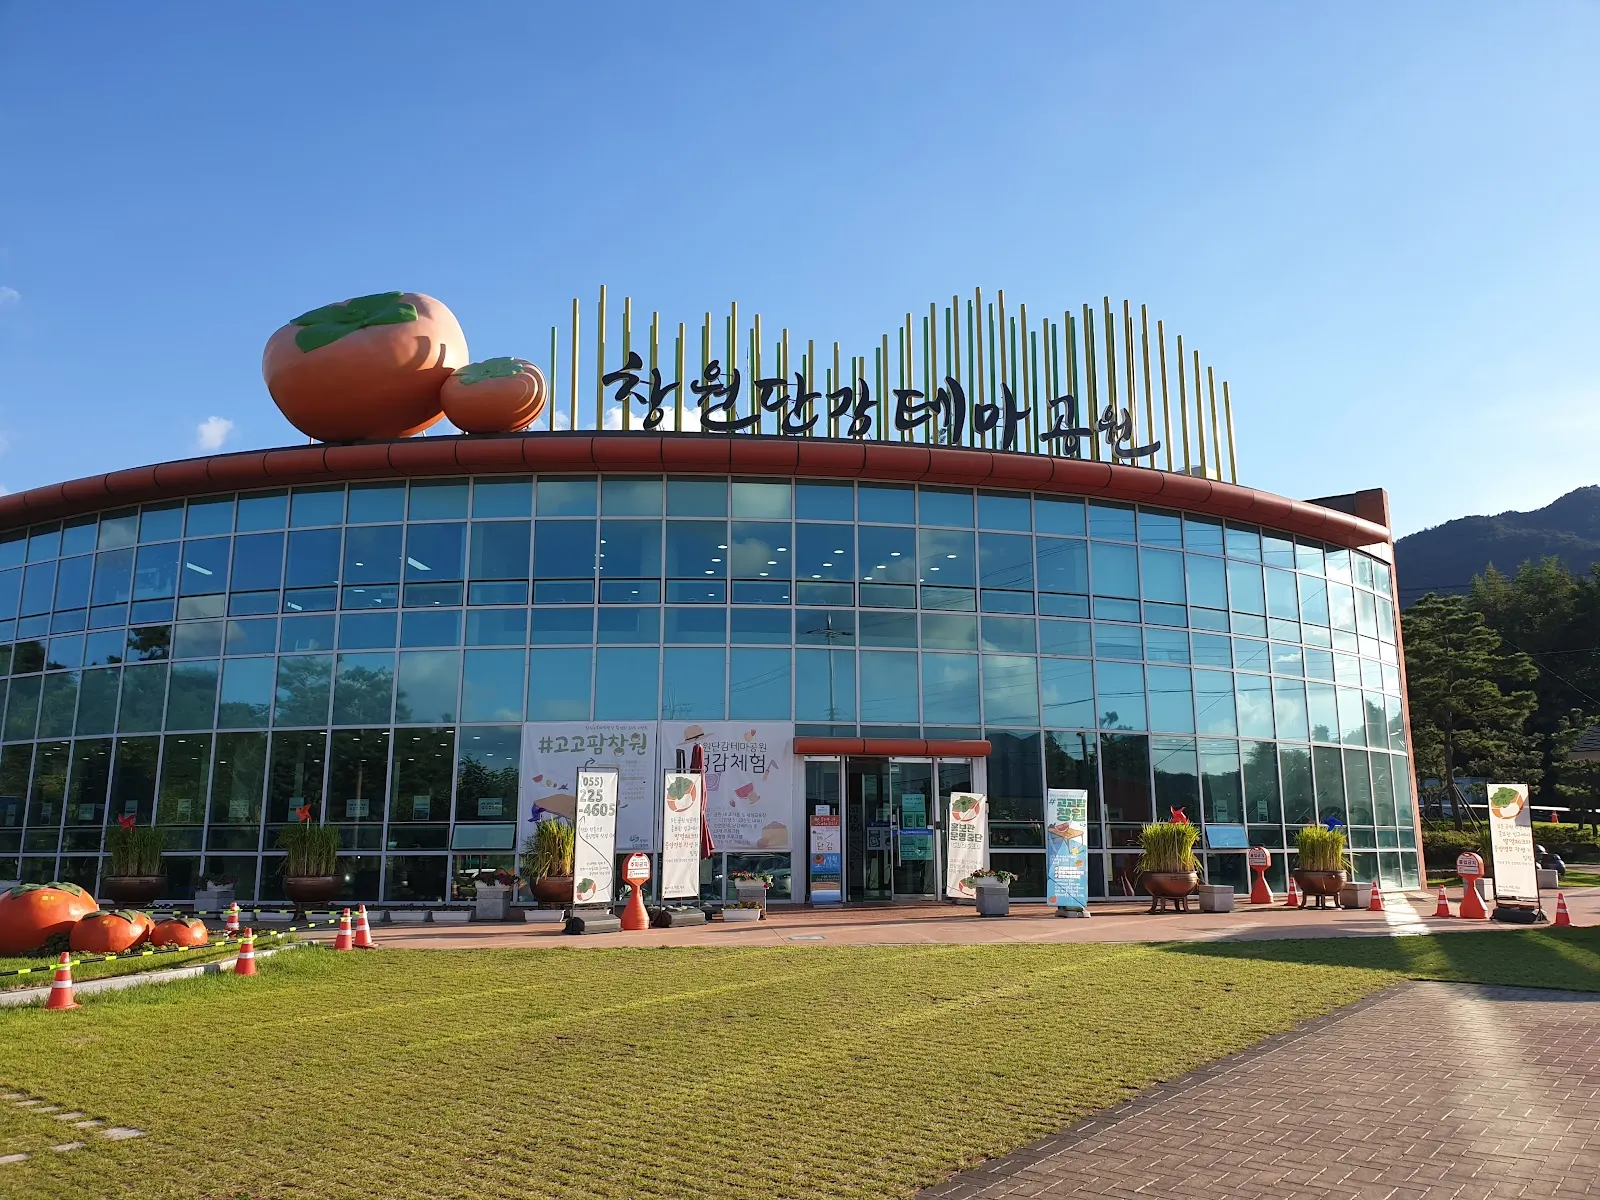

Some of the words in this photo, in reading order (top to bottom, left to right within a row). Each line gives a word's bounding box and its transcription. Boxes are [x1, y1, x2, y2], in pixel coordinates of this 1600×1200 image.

[694, 741, 767, 753] 원단감테마공원
[580, 776, 603, 788] (055)
[580, 789, 603, 802] 225
[579, 803, 616, 816] -4605
[951, 822, 976, 833] 홍보관
[951, 831, 983, 843] 운영중단
